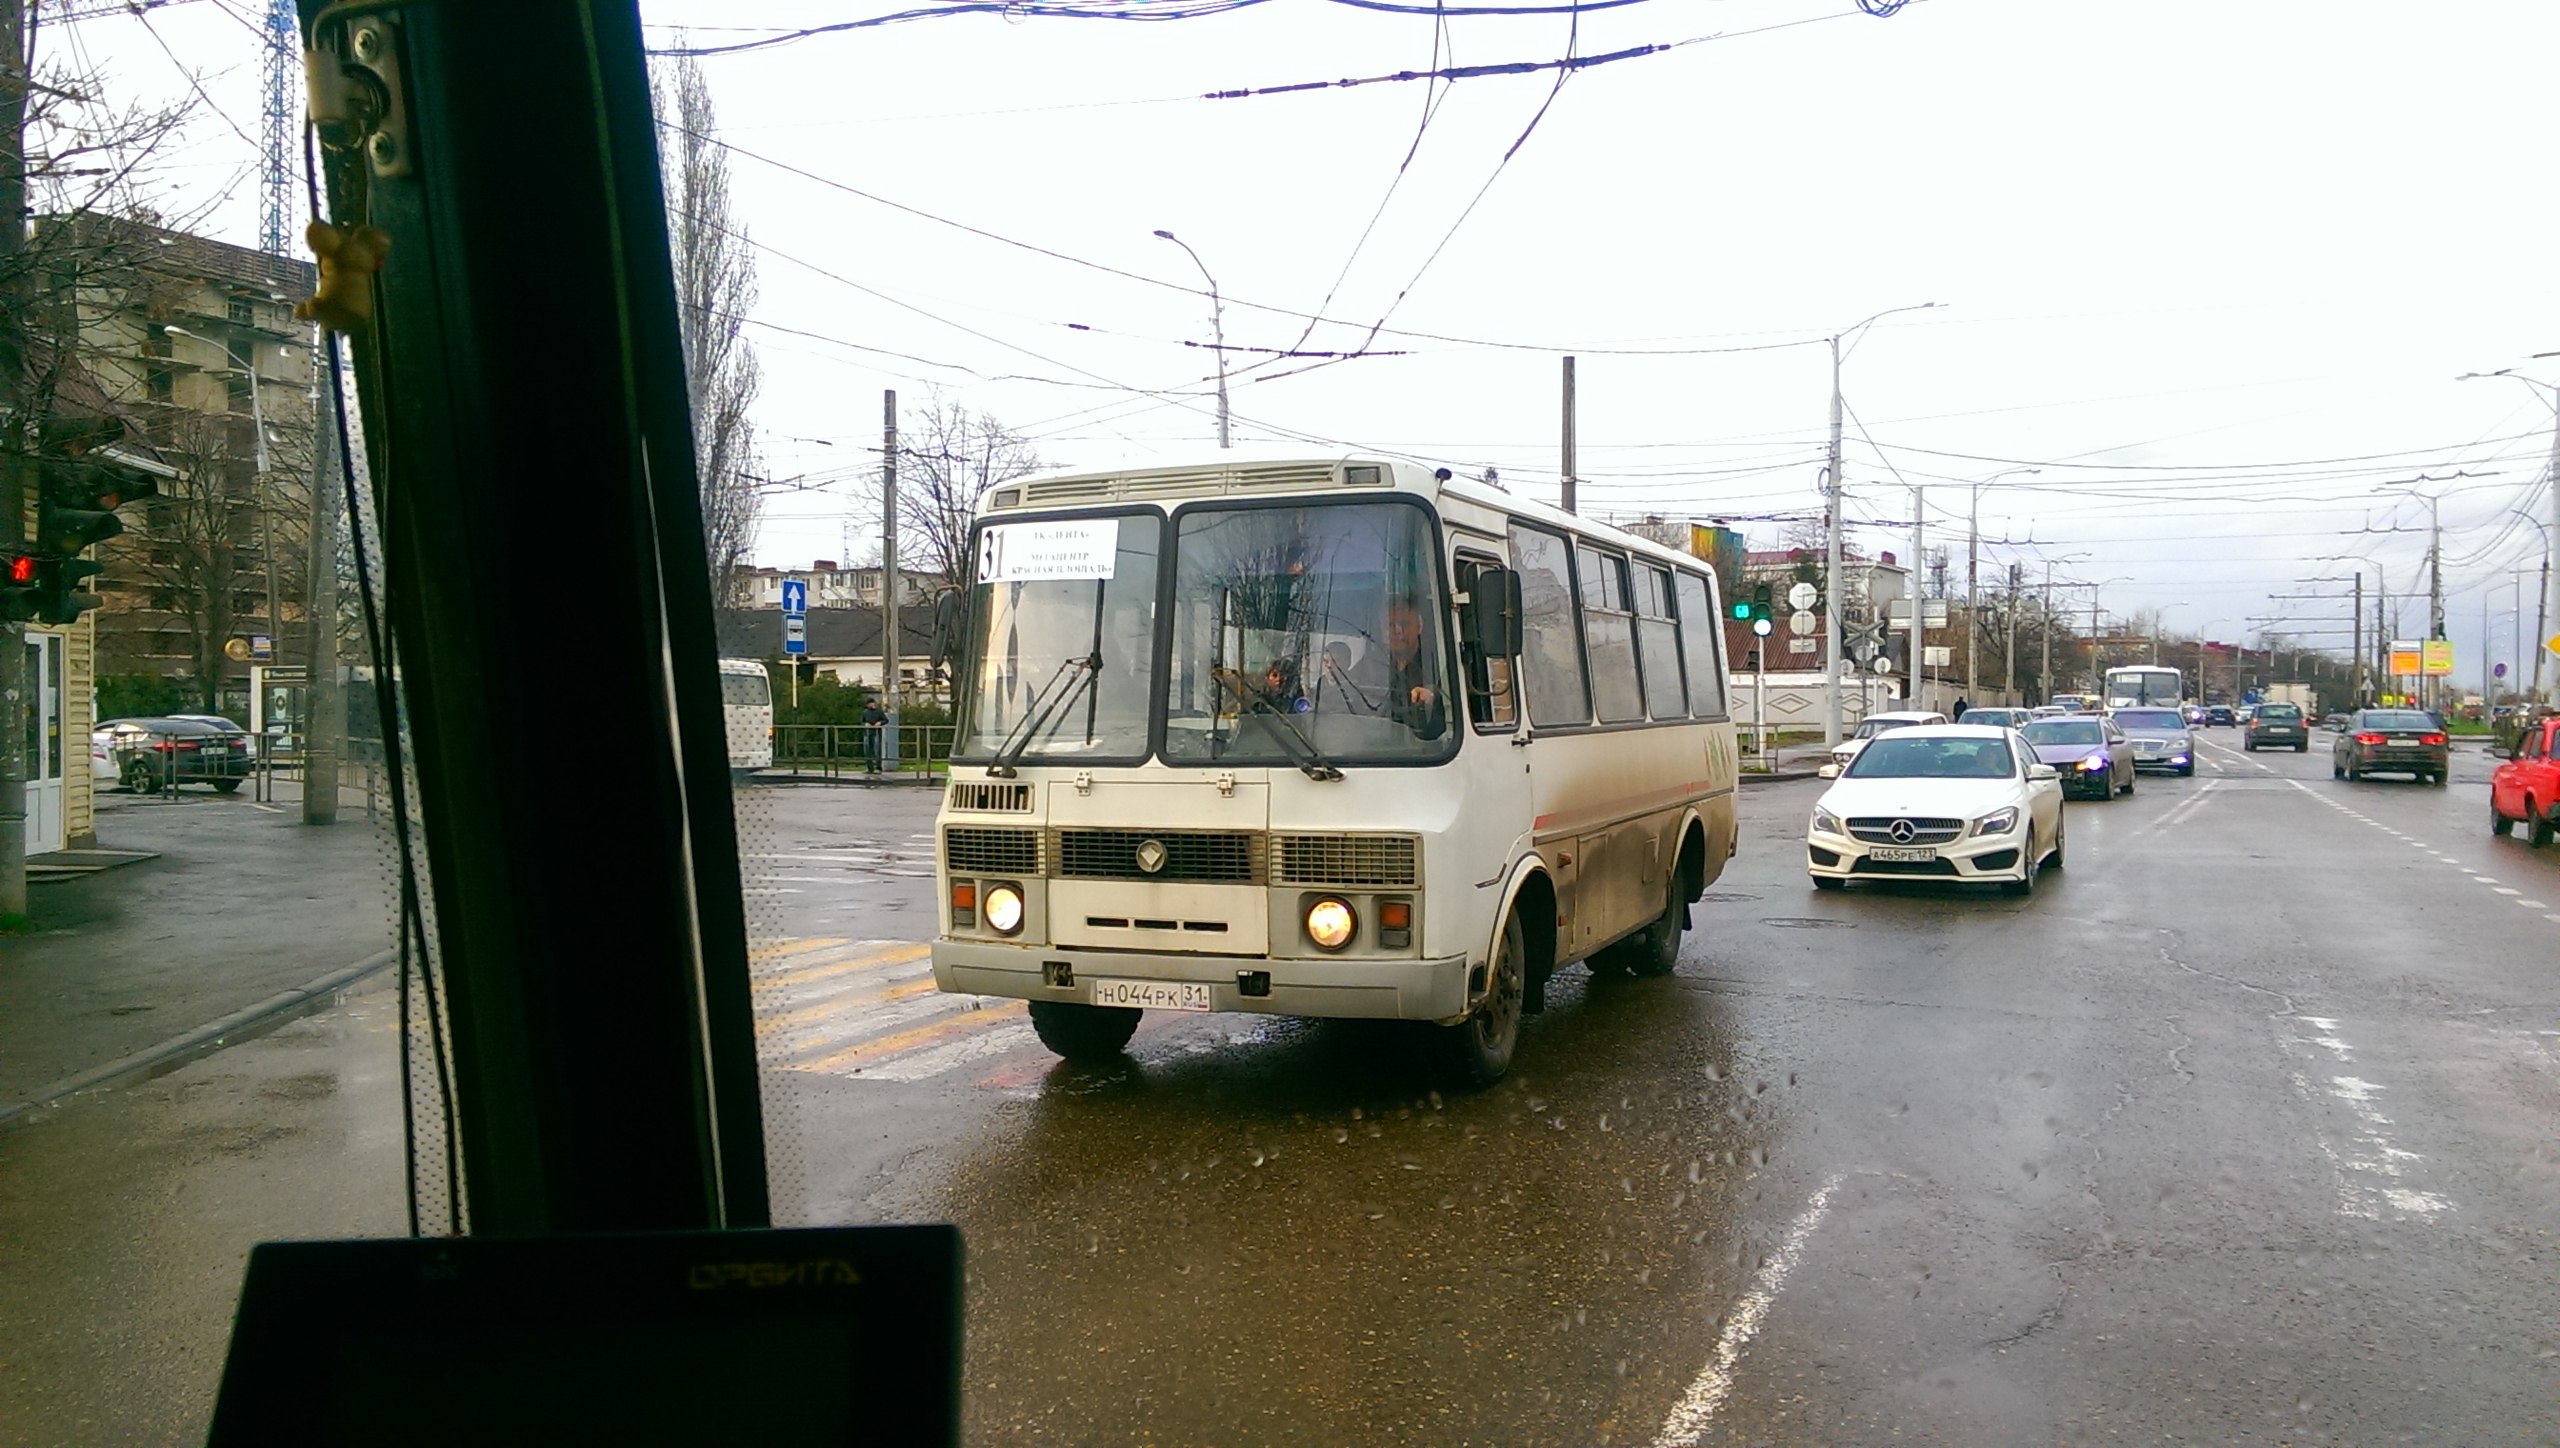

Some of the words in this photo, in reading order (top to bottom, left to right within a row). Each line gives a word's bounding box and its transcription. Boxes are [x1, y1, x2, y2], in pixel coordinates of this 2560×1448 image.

[980, 529, 1006, 581] 31
[1917, 850, 1933, 859] 123
[1104, 984, 1178, 1007] Н044РК
[1184, 985, 1203, 1002] 31
[688, 1258, 864, 1290] ОРБИТА
